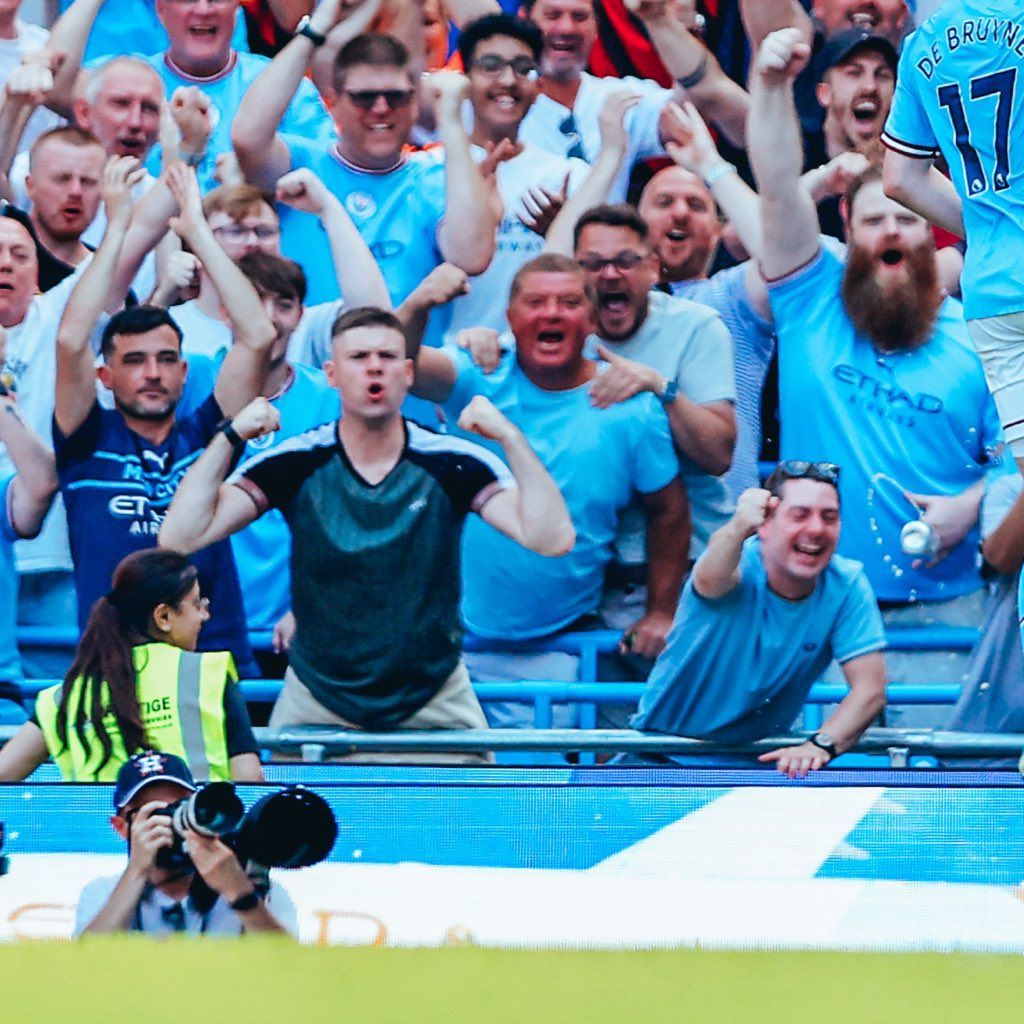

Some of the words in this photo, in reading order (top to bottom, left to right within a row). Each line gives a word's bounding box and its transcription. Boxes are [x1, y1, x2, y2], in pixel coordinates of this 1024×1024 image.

[917, 41, 943, 79] DE
[937, 67, 1018, 197] 17
[832, 363, 944, 414] ETHAD
[145, 696, 171, 714] IGE
